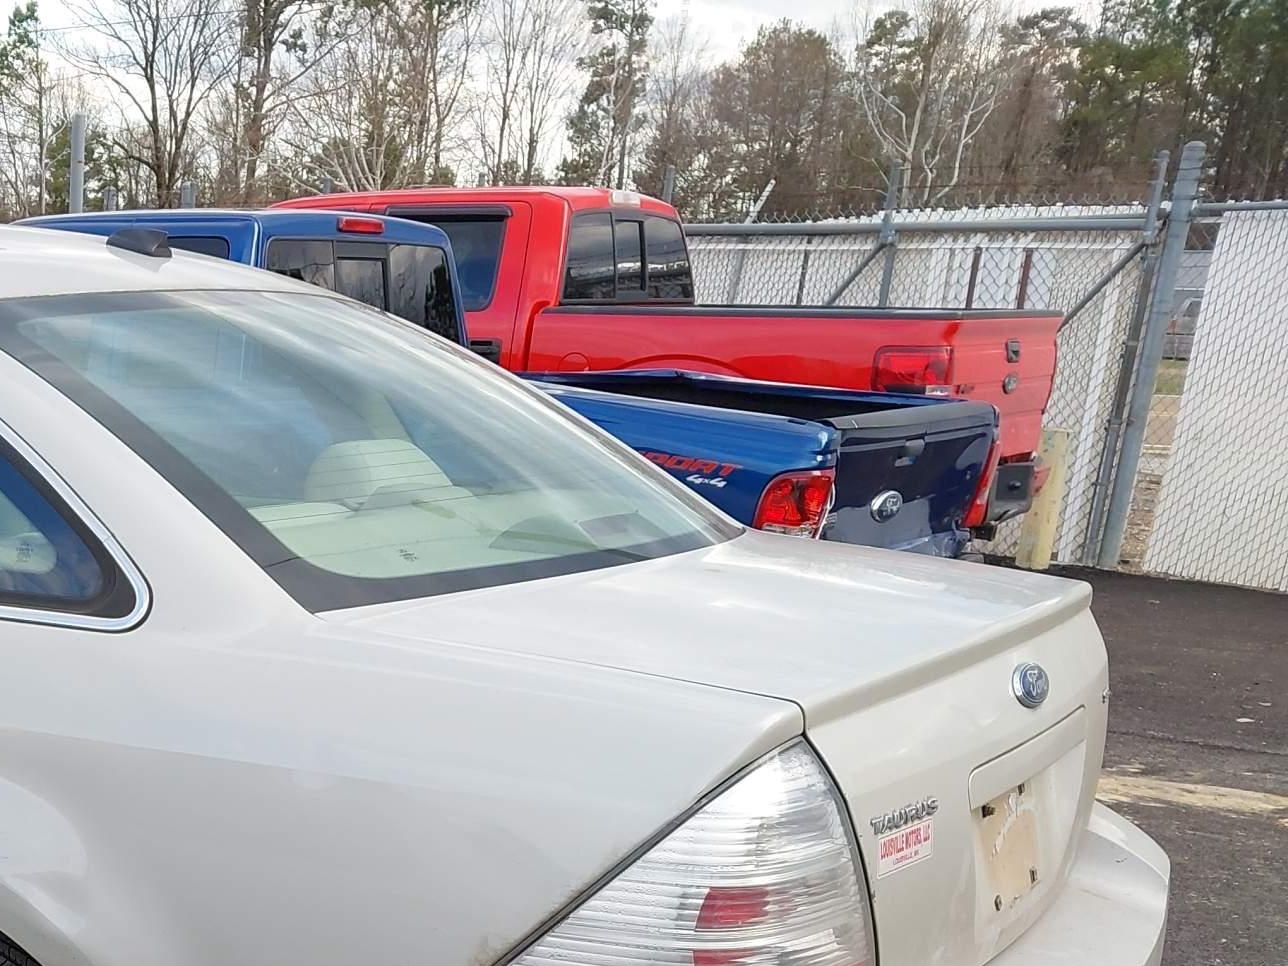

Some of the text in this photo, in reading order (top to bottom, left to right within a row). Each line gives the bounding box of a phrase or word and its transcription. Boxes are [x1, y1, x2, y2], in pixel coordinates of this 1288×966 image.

[638, 450, 744, 477] PORT
[686, 474, 727, 488] 4x4
[870, 797, 938, 835] TAURUS
